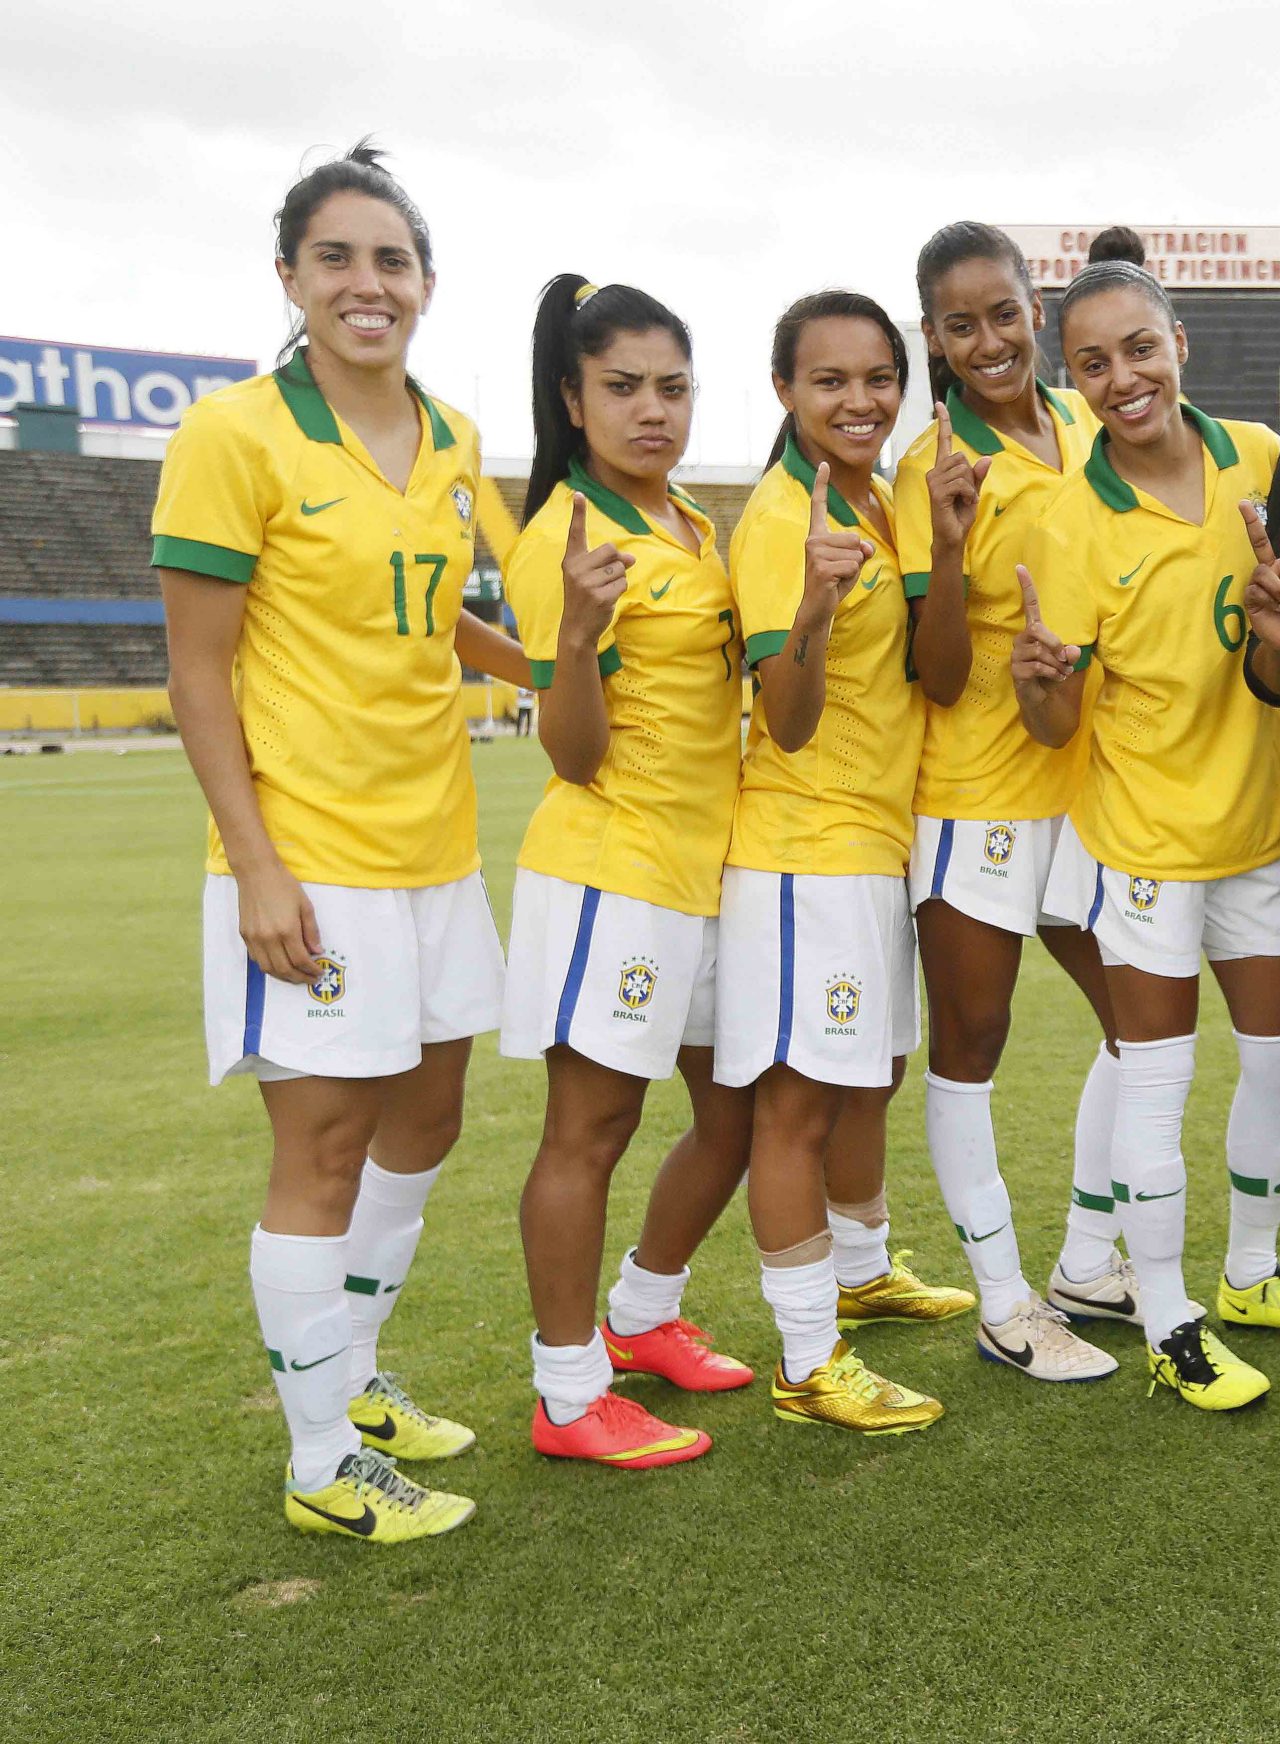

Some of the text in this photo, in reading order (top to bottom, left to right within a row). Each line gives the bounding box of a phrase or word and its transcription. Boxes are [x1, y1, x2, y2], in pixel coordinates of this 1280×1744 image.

[389, 551, 448, 637] 17
[1213, 574, 1247, 653] 6
[979, 866, 1009, 878] BRASIL
[1124, 910, 1155, 924] BRASIL
[307, 1008, 346, 1018] BRASIL
[612, 1010, 648, 1023] BRASIL
[825, 1027, 858, 1036] BRASIL
